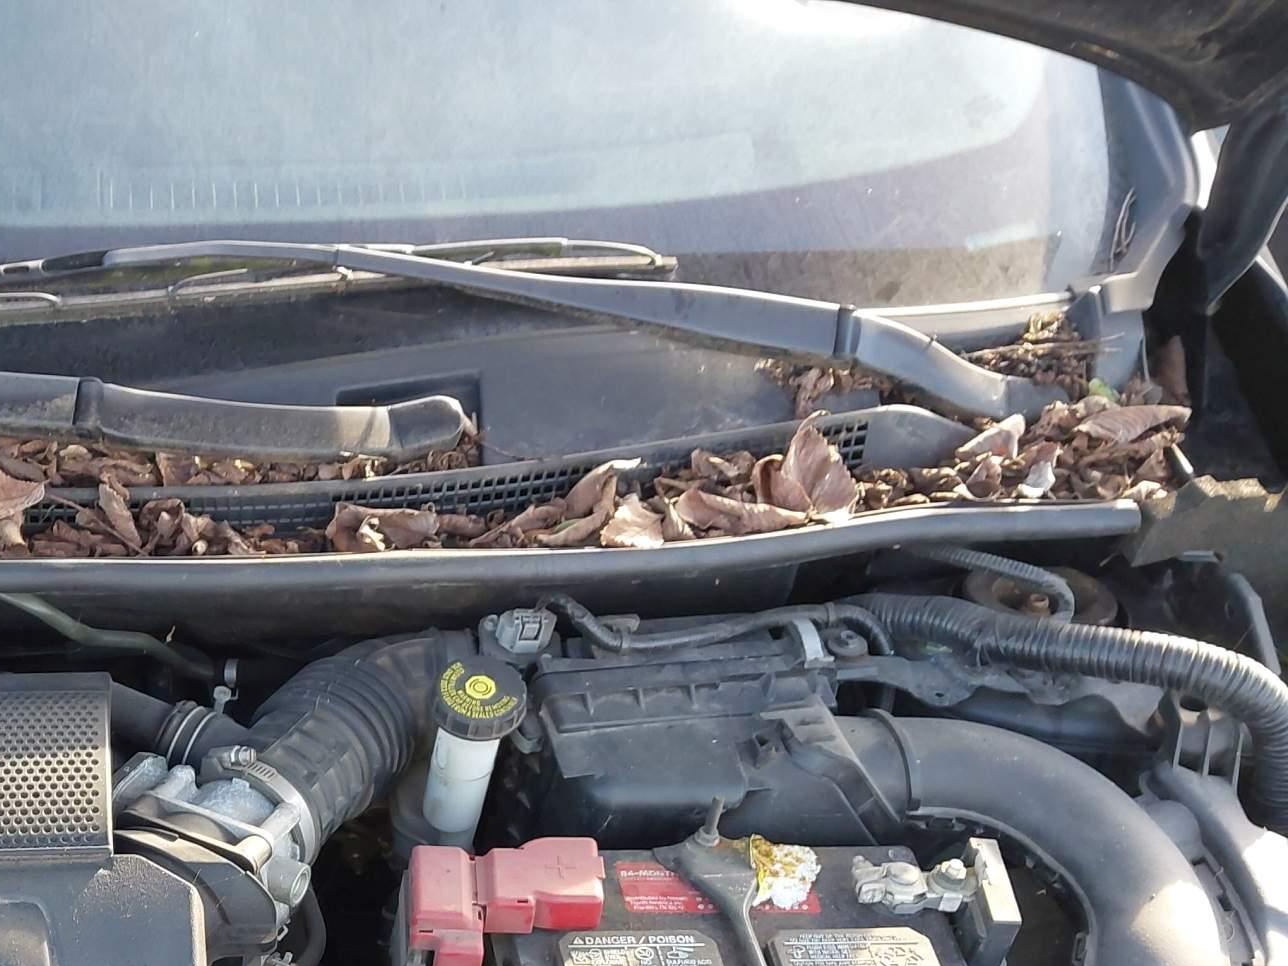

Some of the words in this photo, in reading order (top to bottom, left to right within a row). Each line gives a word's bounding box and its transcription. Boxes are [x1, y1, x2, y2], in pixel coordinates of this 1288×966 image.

[585, 936, 637, 945] DANGER
[639, 936, 646, 945] /
[648, 935, 694, 944] POISON
